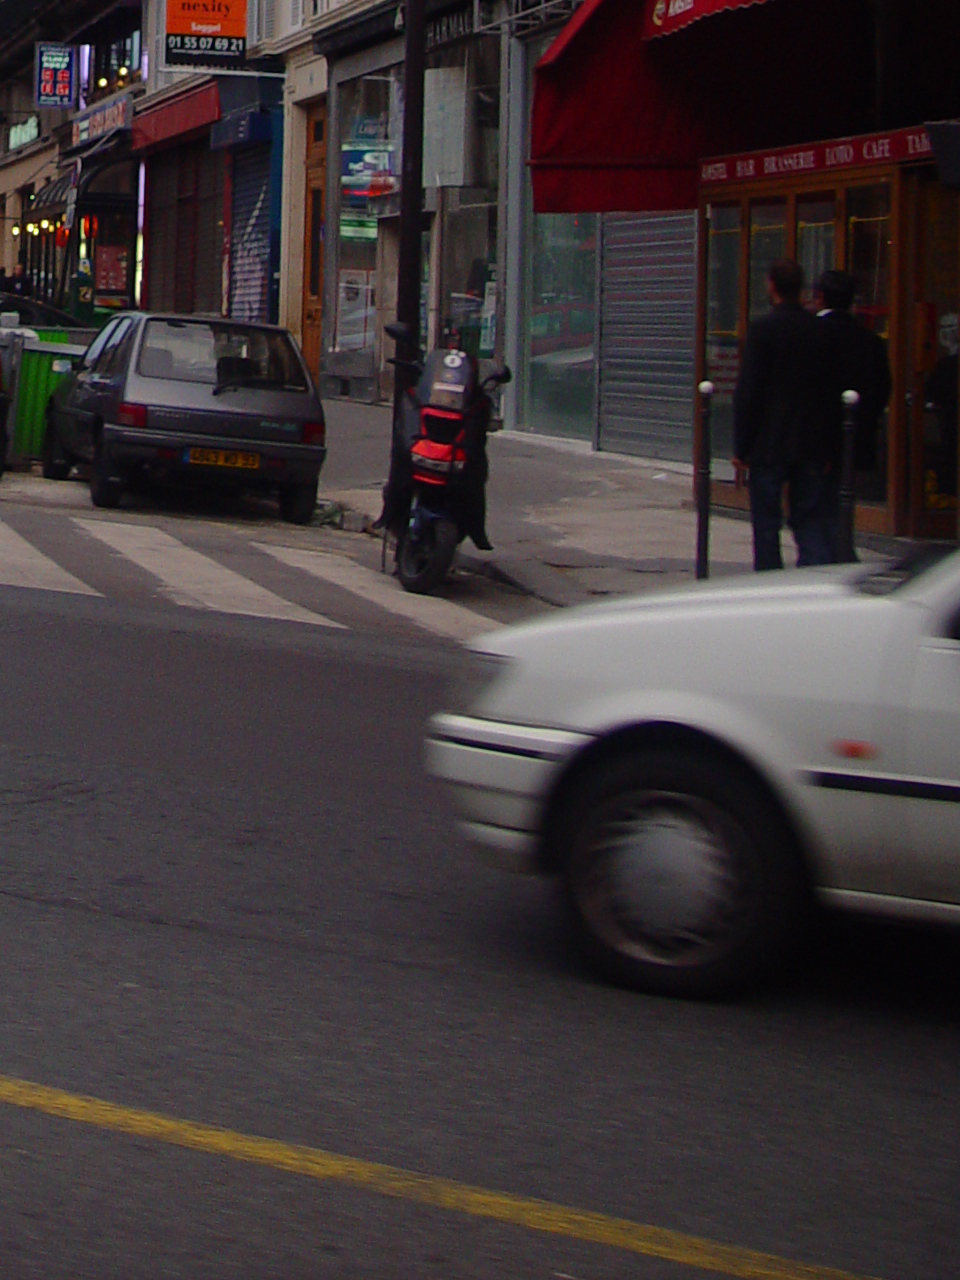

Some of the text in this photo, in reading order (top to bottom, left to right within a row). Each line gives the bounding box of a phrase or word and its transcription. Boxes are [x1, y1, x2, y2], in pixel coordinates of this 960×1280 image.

[181, 0, 233, 17] nexity
[168, 36, 244, 51] 01 55 07 69 21
[736, 159, 755, 177] BAR
[763, 150, 815, 174] BRASSERIE
[825, 144, 854, 166] LOTO
[862, 138, 892, 160] CAFE
